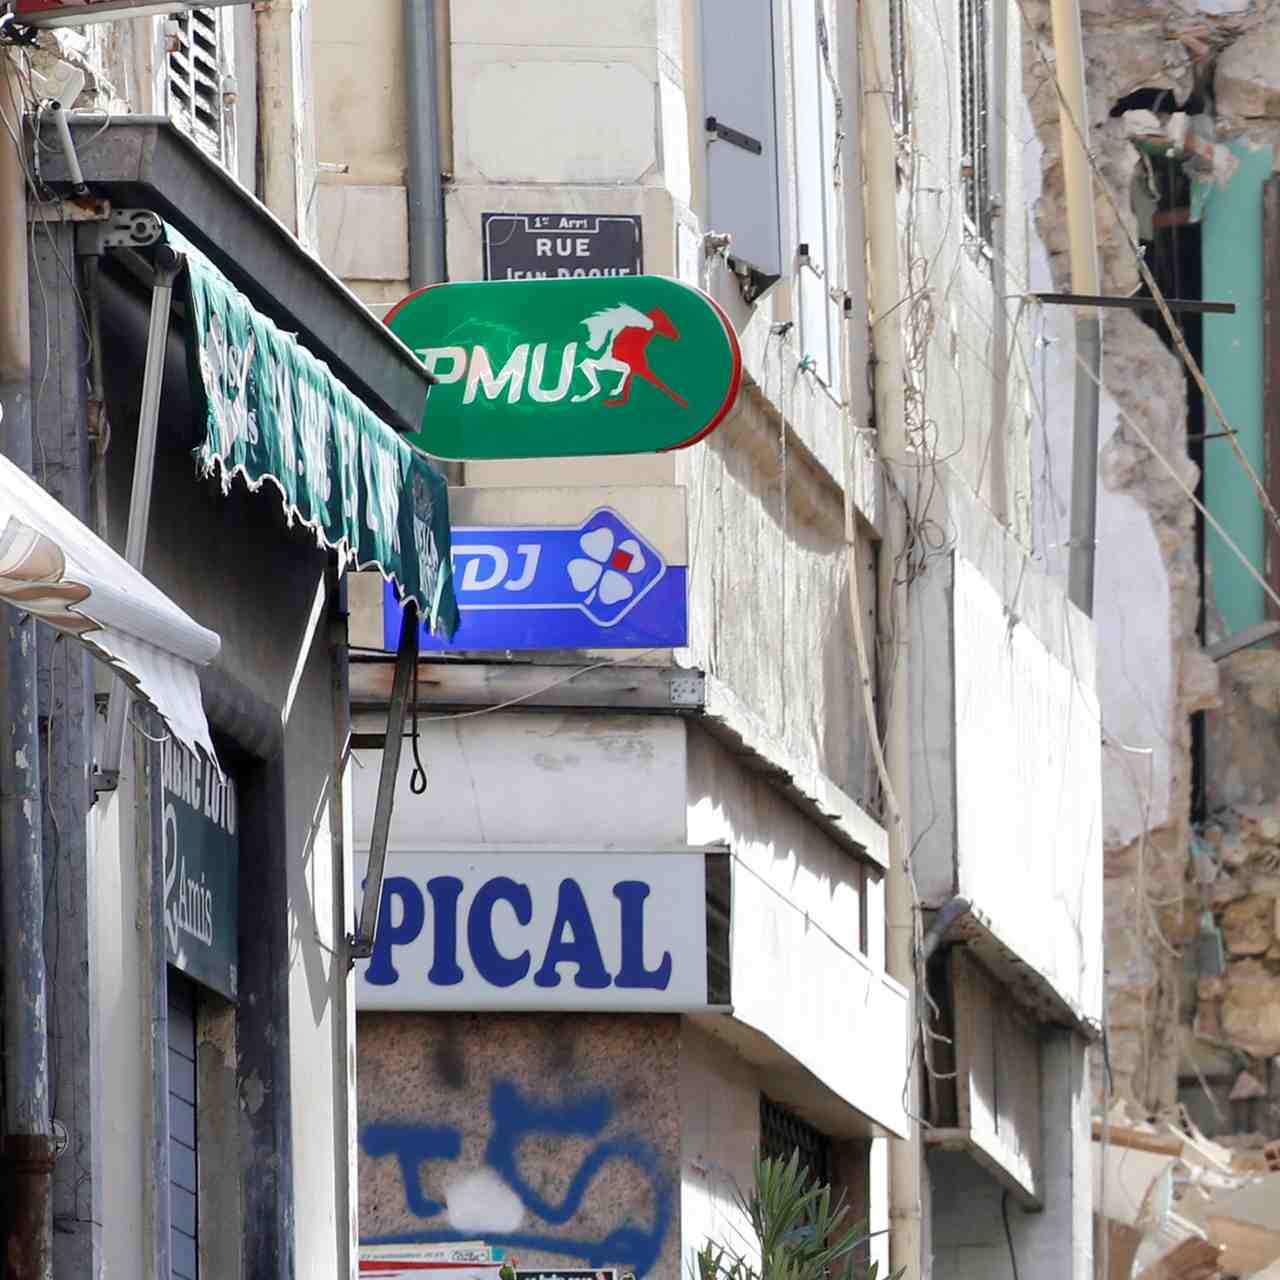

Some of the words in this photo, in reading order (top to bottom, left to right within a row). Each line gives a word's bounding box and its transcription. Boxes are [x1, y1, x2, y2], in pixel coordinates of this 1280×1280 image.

[536, 238, 590, 257] RUE
[414, 342, 578, 405] PMU
[451, 543, 542, 591] DJ
[360, 875, 673, 991] PICAL
